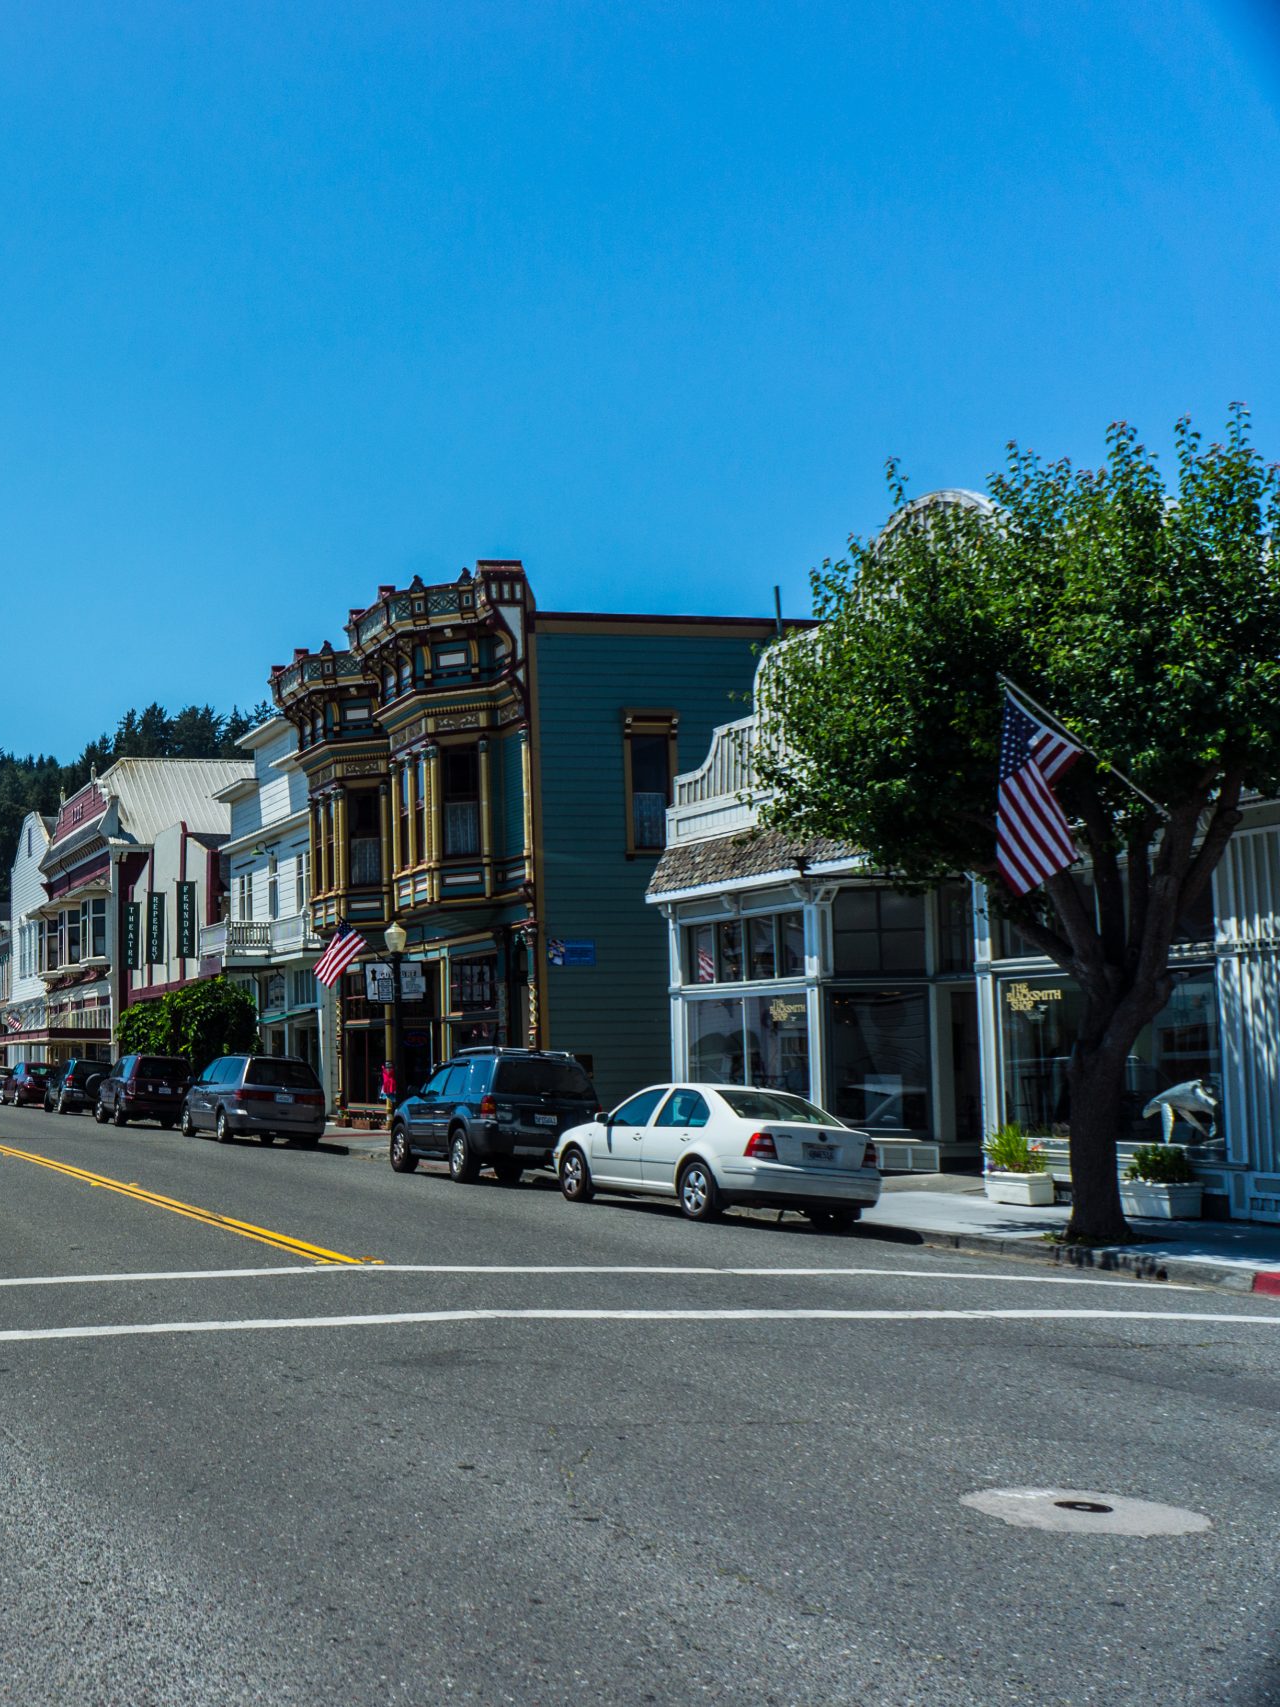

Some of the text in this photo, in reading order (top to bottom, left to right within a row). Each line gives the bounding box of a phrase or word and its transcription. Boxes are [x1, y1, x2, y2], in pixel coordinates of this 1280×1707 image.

[151, 896, 159, 960] REPERTORY
[127, 906, 135, 965] THEATRE
[380, 969, 417, 977] COUURE
[1010, 983, 1029, 996] THE
[1006, 990, 1062, 1002] BLACKSMITH
[1011, 1001, 1034, 1011] SHOP
